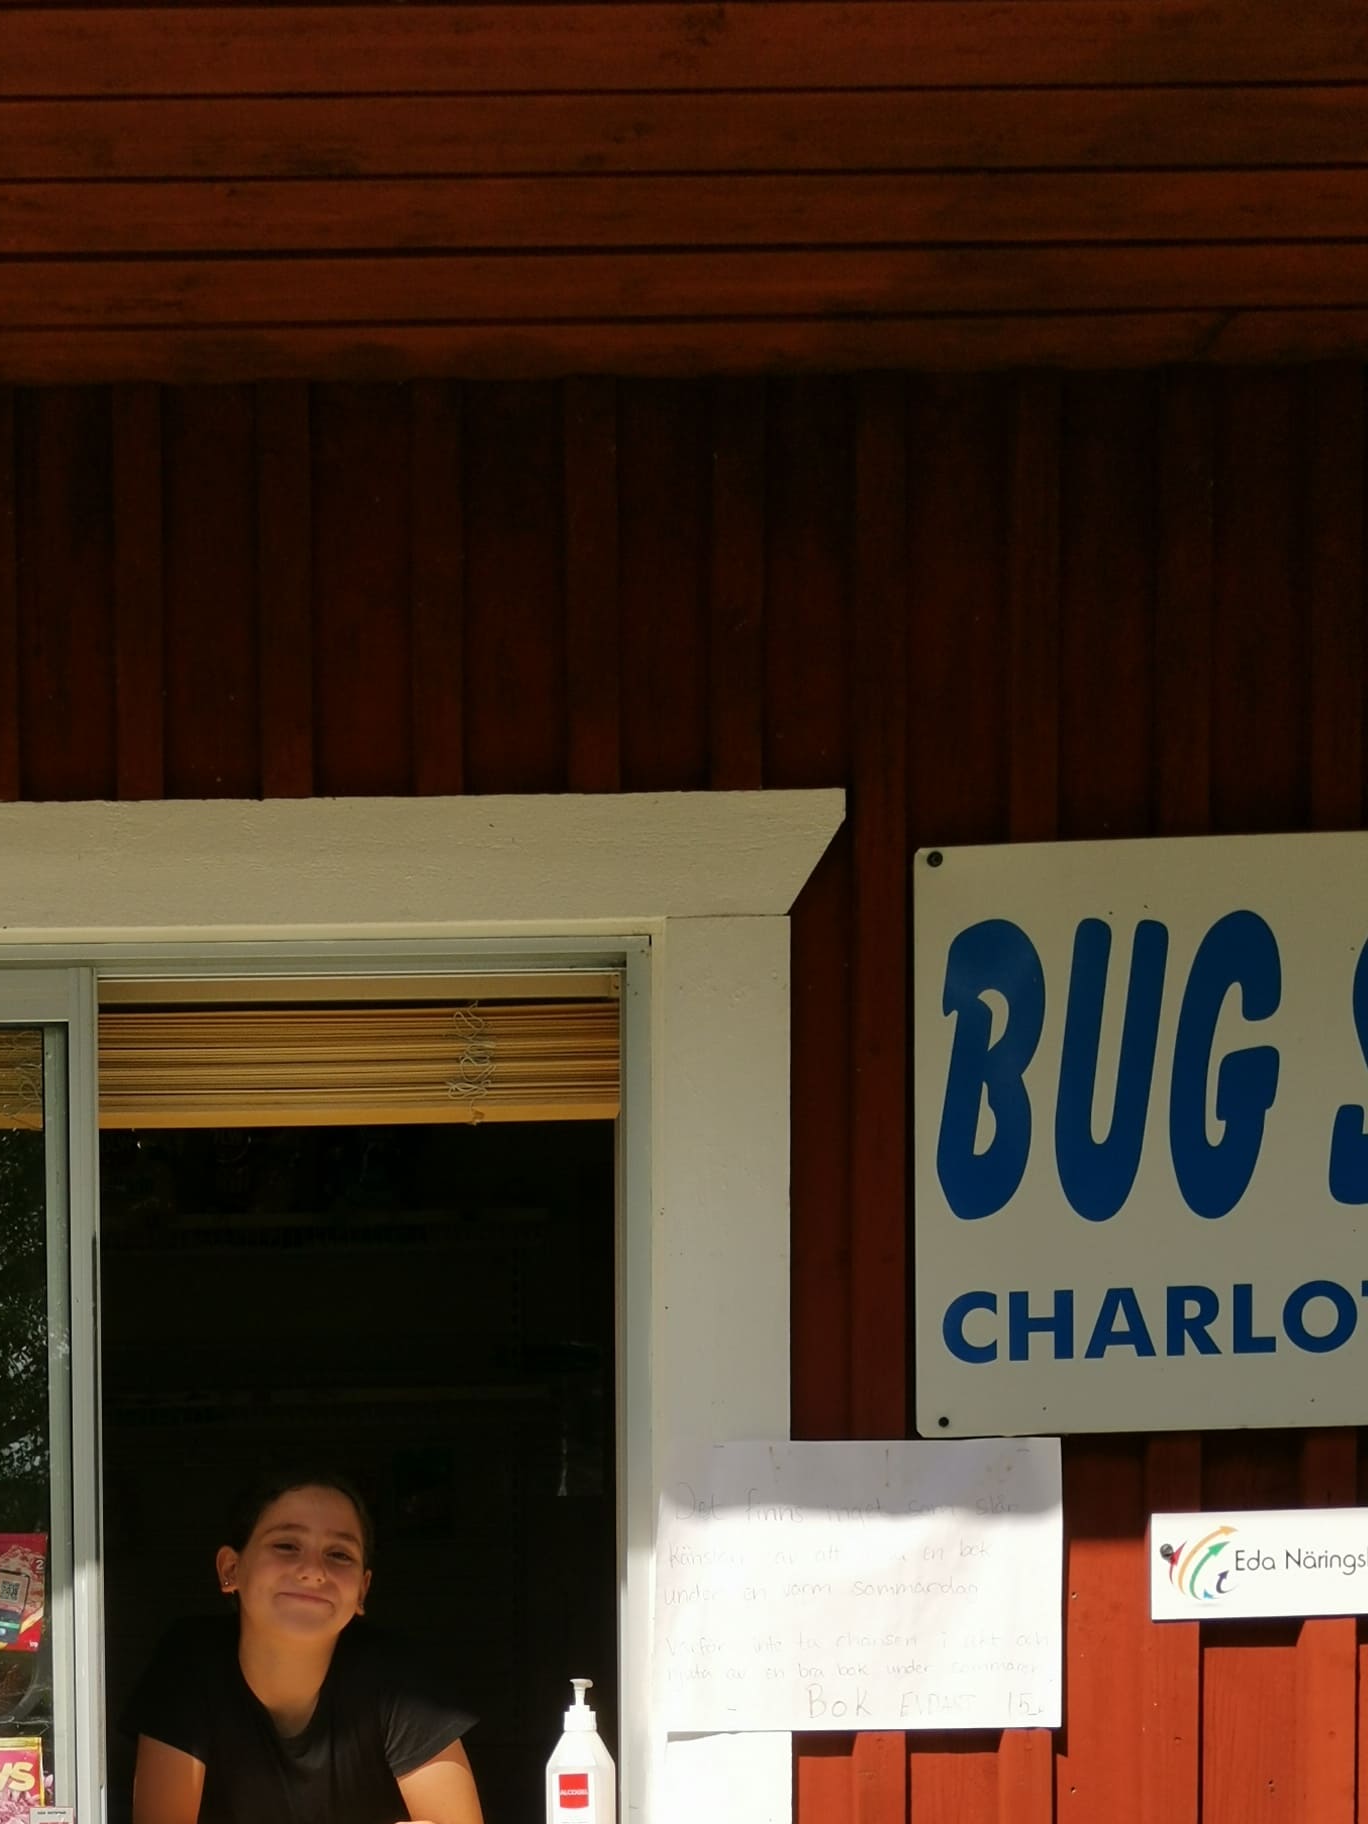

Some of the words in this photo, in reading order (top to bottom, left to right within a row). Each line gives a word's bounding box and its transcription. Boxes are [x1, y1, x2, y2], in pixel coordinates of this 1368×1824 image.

[936, 909, 1282, 1222] BUG
[942, 1279, 1368, 1364] CHARLO
[745, 1488, 803, 1524] finns
[1235, 1549, 1276, 1571] Eda
[1285, 1548, 1368, 1576] Närings
